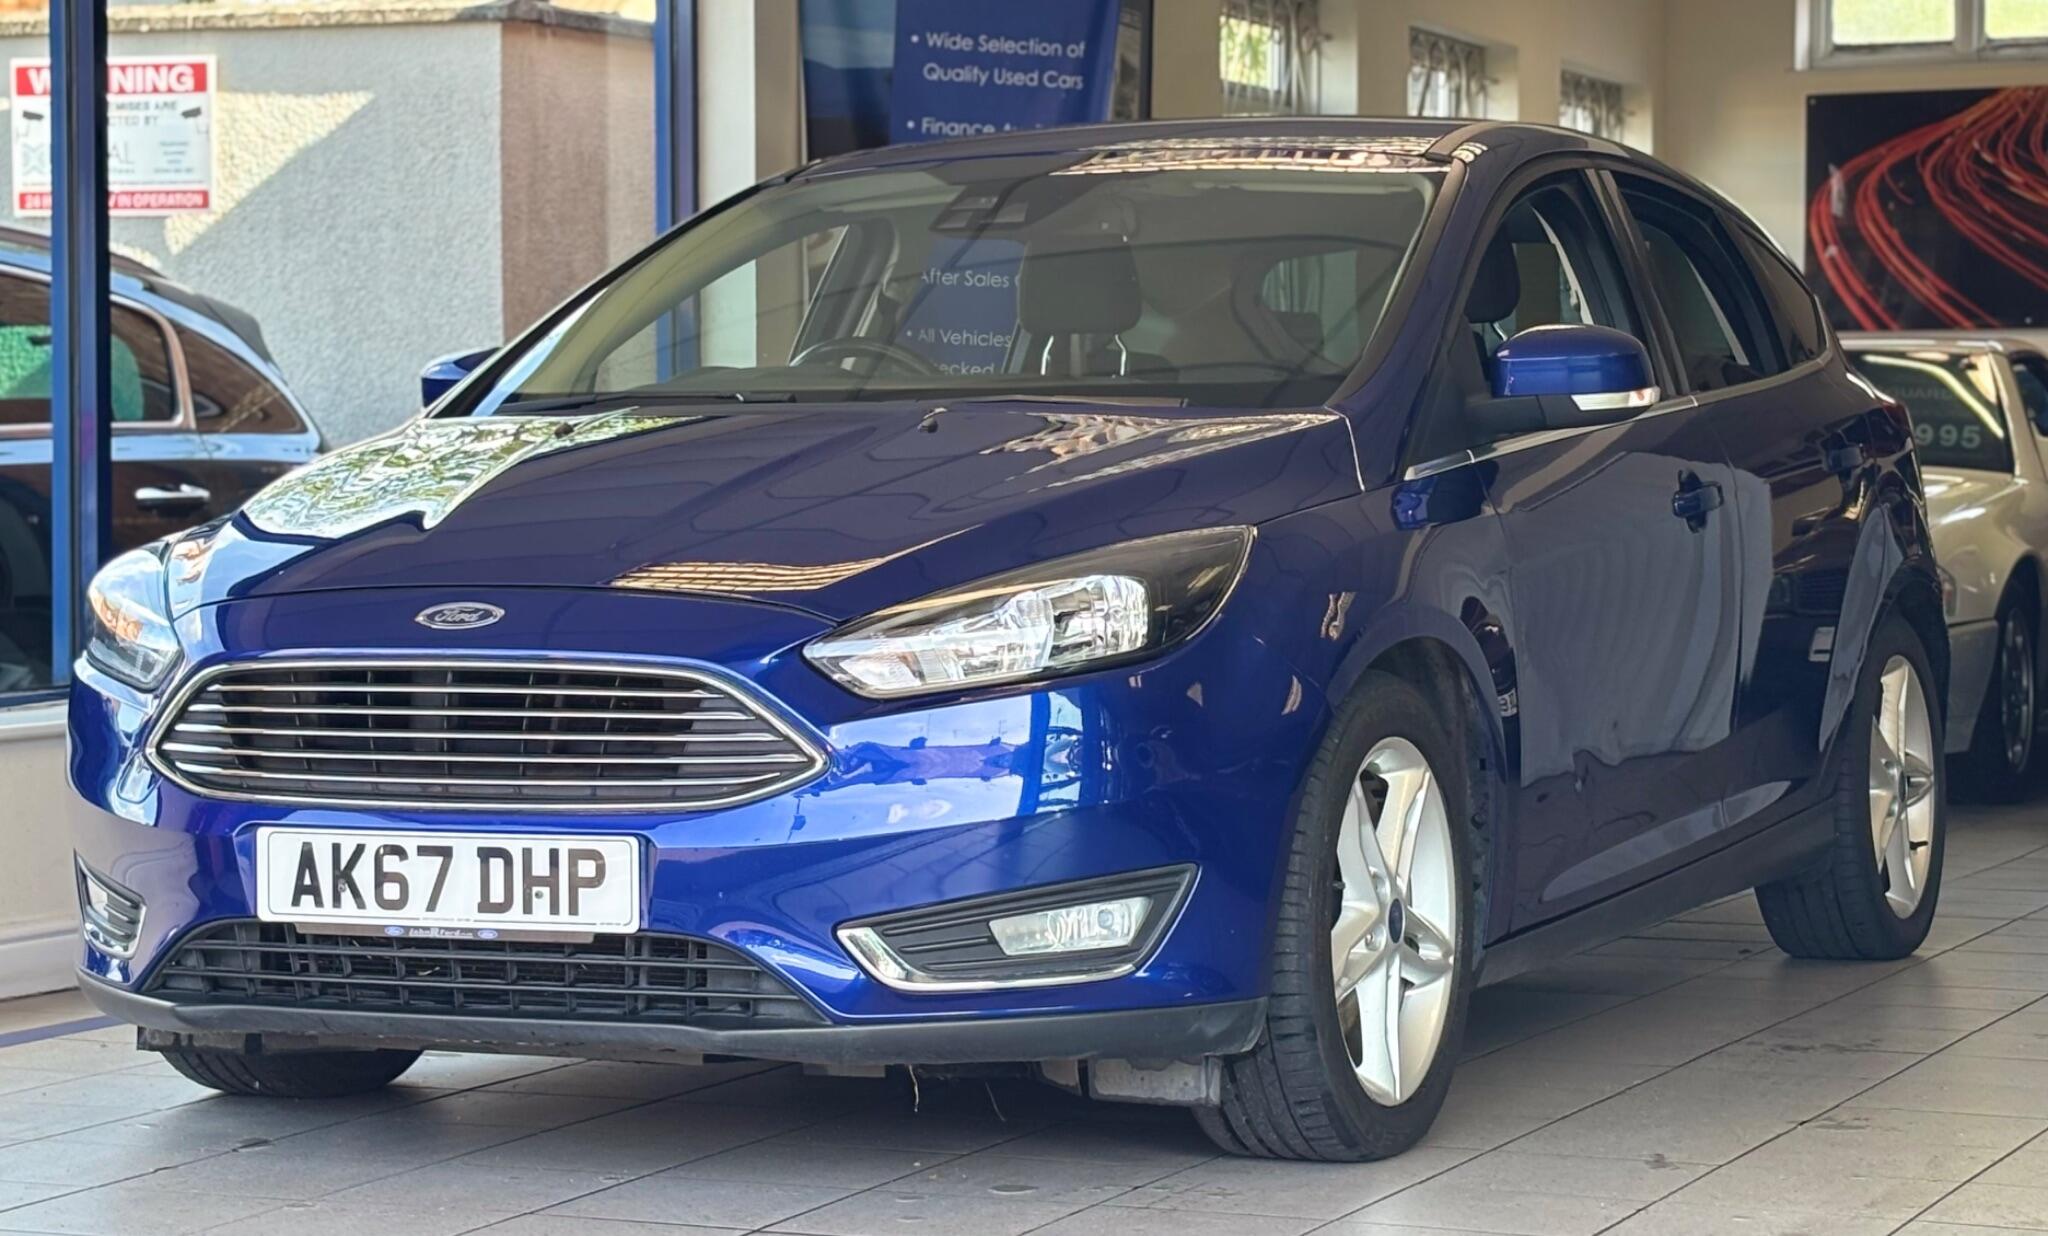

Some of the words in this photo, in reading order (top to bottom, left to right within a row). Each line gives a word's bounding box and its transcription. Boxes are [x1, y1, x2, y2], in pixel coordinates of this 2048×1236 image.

[926, 32, 974, 51] Wide
[978, 35, 1062, 57] Selection
[1066, 41, 1085, 58] of
[27, 65, 194, 94] WNING
[923, 62, 989, 87] Quality
[993, 68, 1039, 86] Used
[1043, 71, 1083, 90] Cars
[921, 117, 996, 136] Finance
[964, 270, 1010, 288] Sales
[917, 328, 935, 341] All
[939, 329, 1013, 347] Vehicles
[434, 607, 485, 622] Ford
[291, 841, 454, 912] AK67
[477, 847, 606, 916] DHP
